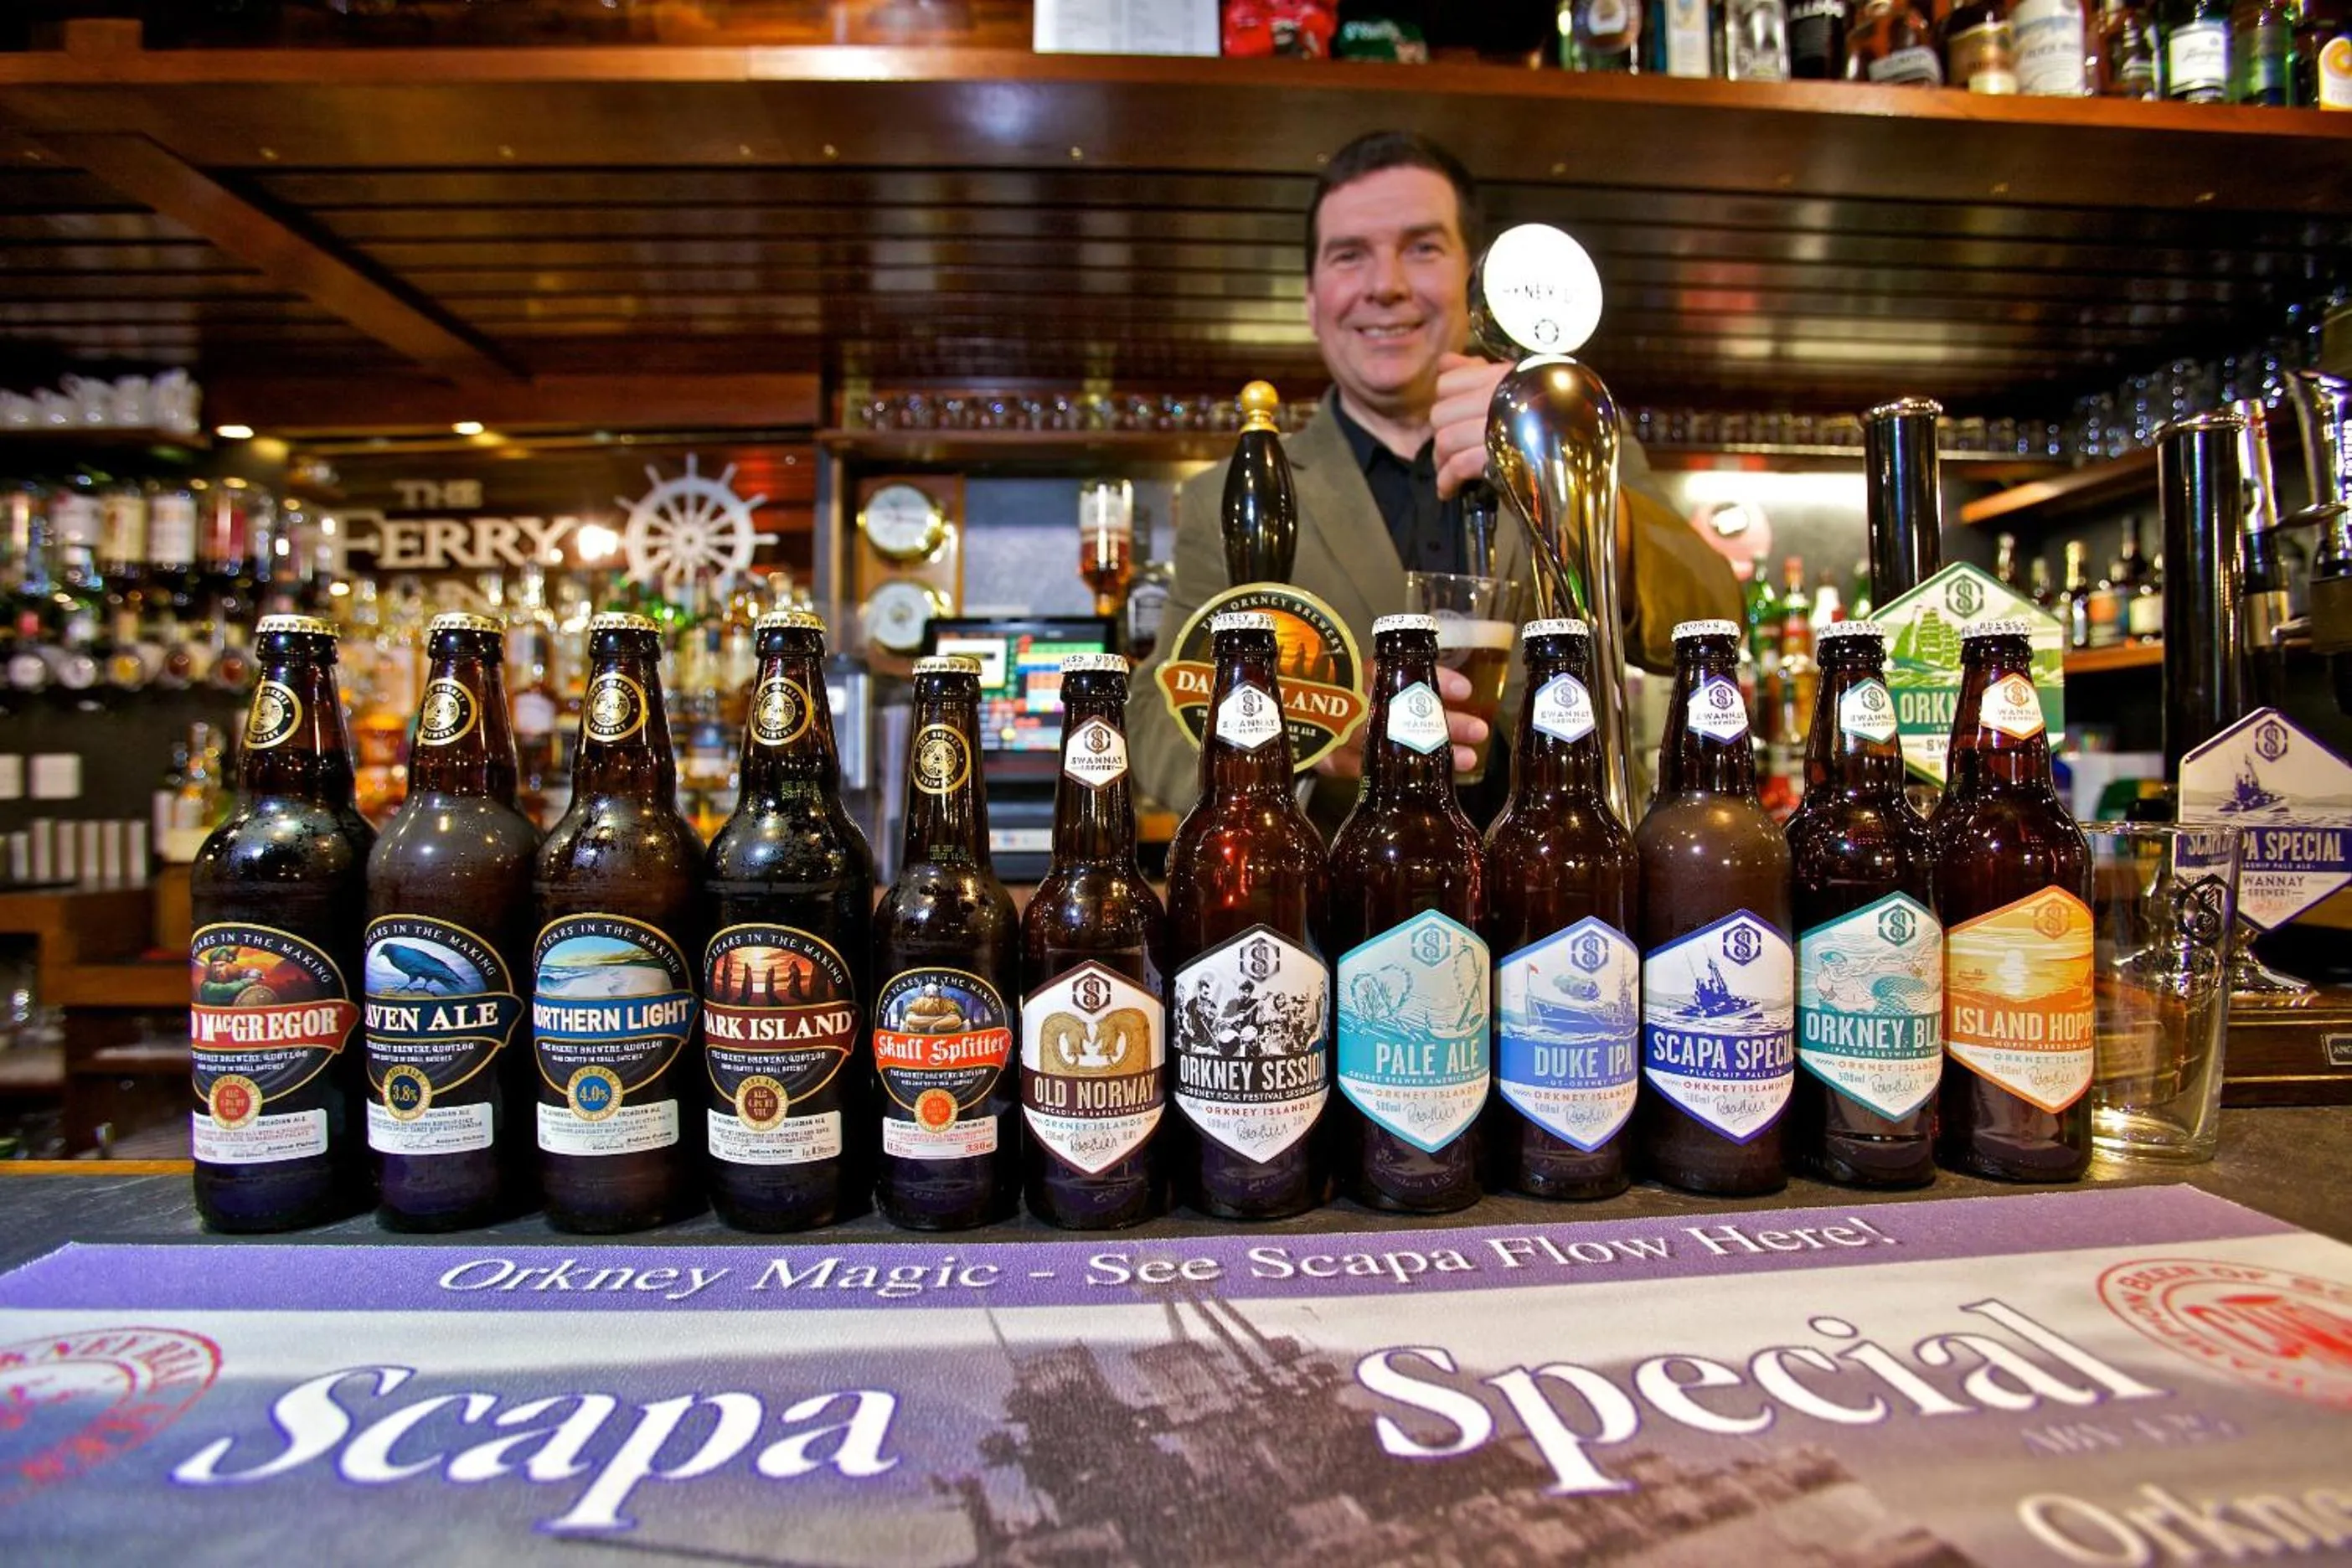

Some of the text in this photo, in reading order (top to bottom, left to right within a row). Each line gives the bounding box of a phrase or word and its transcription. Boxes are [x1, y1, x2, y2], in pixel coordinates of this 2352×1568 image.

[393, 479, 483, 508] THE
[332, 509, 580, 576] FERRY
[1230, 595, 1289, 611] ORKNEY
[1294, 602, 1346, 655] BREWERY
[1175, 669, 1349, 718] DA LAND
[2264, 831, 2345, 862] SPECIAL
[2243, 875, 2305, 887] WANNAY
[221, 933, 235, 941] IN
[244, 933, 274, 947] THE
[394, 925, 407, 933] IN
[415, 926, 443, 939] THE
[450, 935, 497, 977] MAKING
[542, 925, 573, 948] YEARS
[580, 924, 596, 933] IN
[605, 925, 633, 938] THE
[712, 936, 741, 957] YEARS
[748, 934, 761, 942] IN
[770, 935, 798, 948] THE
[942, 976, 966, 987] THE
[365, 1002, 498, 1032] AVEN ALE
[627, 998, 689, 1030] LIGHT
[749, 1010, 853, 1041] ISLAND
[1954, 1005, 2094, 1042] ISLAND HOPP
[1805, 1012, 1906, 1048] ORKNEY
[877, 1033, 1005, 1065] Skull Splitter
[1375, 1037, 1480, 1075] PALE ALE
[1534, 1042, 1632, 1079] DUKE IPA
[1653, 1031, 1727, 1070] SCAPA
[1179, 1049, 1327, 1091] ORKNEY SESSION
[1689, 1070, 1741, 1078] FLAGSHIP
[1838, 1062, 1893, 1072] ORKNEY
[1034, 1074, 1155, 1110] OLD NORWAY
[1217, 1090, 1240, 1101] FOLK
[1243, 1091, 1283, 1101] FESTIVAL
[1375, 1084, 1478, 1100] ORKNEY ISLANDS
[1534, 1091, 1586, 1101] ORKNEY
[1684, 1081, 1736, 1093] ORKNEY
[1044, 1118, 1142, 1131] ORKNEY ISLANDS
[1205, 1102, 1311, 1117] ORKNEY ISLANDS
[439, 1257, 730, 1300] Orkney
[755, 1256, 1003, 1297] Magic
[1086, 1252, 1223, 1285] See
[1251, 1245, 1478, 1287] Scapa
[1487, 1233, 1678, 1268] Flow
[1683, 1216, 1899, 1256] Here!
[172, 1364, 901, 1534] Scapa
[1354, 1298, 2174, 1495] Special
